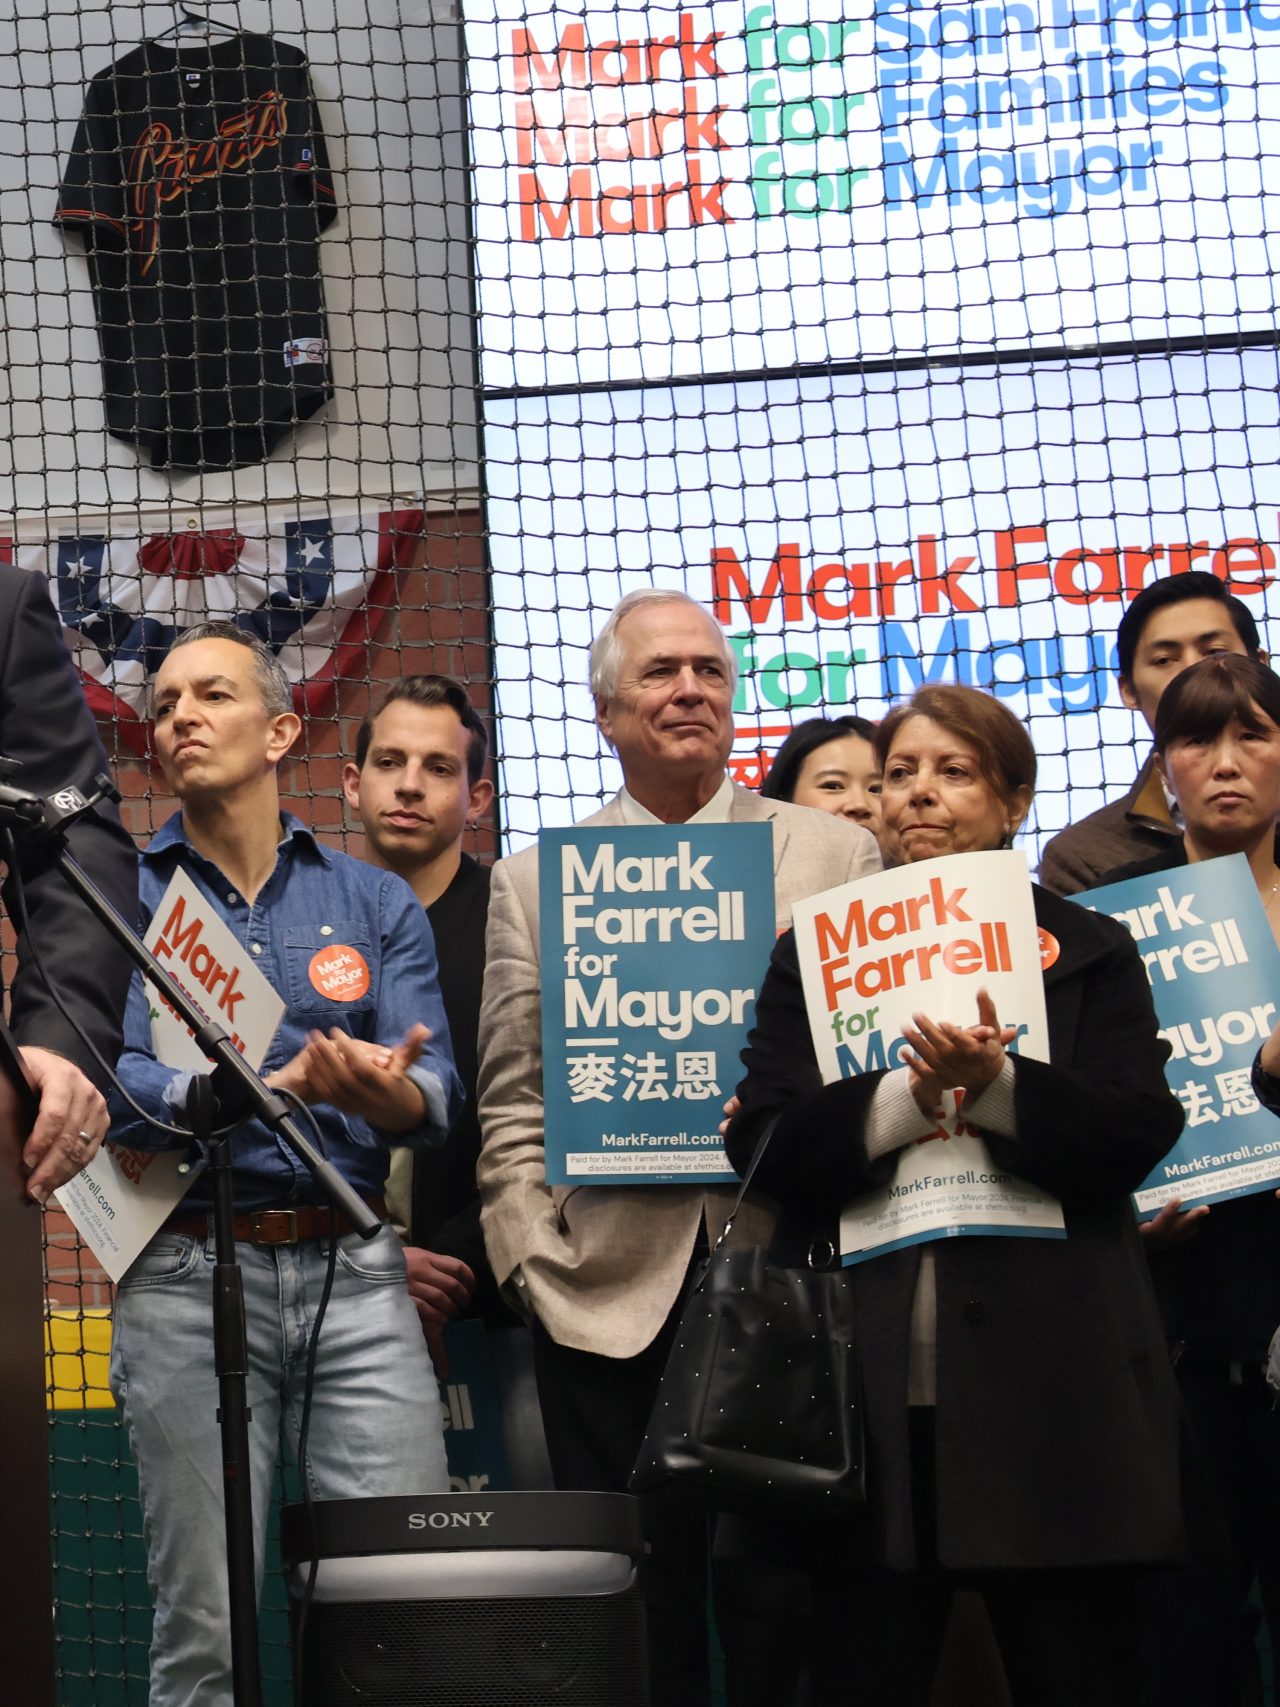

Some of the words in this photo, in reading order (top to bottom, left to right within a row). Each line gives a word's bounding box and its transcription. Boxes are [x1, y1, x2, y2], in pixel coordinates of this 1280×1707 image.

[510, 13, 728, 95] Mark
[738, 5, 861, 73] for
[875, 0, 1016, 64] San
[514, 85, 733, 168] Mark
[745, 78, 866, 147] for
[879, 50, 1231, 138] Families
[517, 159, 735, 243] Mark
[750, 151, 870, 223] for
[881, 138, 1163, 221] Mayor
[709, 534, 980, 627] Mark
[728, 630, 866, 713] for
[880, 617, 1121, 717] May
[561, 841, 714, 894] Mark
[562, 891, 745, 945] Farrell
[813, 877, 972, 962] Mark
[1092, 885, 1206, 940] ark
[163, 894, 246, 1023] Mark
[314, 951, 353, 977] Mark
[320, 964, 365, 993] Mayor
[563, 946, 618, 977] for
[820, 921, 1013, 1012] Farrell
[1140, 917, 1251, 986] rrell
[564, 978, 755, 1041] Mayor
[830, 1005, 880, 1043] for
[1156, 1001, 1277, 1068] ayor
[565, 1051, 722, 1103] 麥法恩
[589, 1155, 599, 1163] for
[601, 1155, 611, 1165] by
[635, 1154, 657, 1162] Farrell
[660, 1154, 670, 1162] for
[601, 1133, 724, 1147] MarkFarrell.com
[80, 1168, 116, 1221] arrell.com
[588, 1163, 630, 1172] disclosures
[887, 1171, 1013, 1200] MarkFarrell.com
[408, 1512, 494, 1529] SONY
